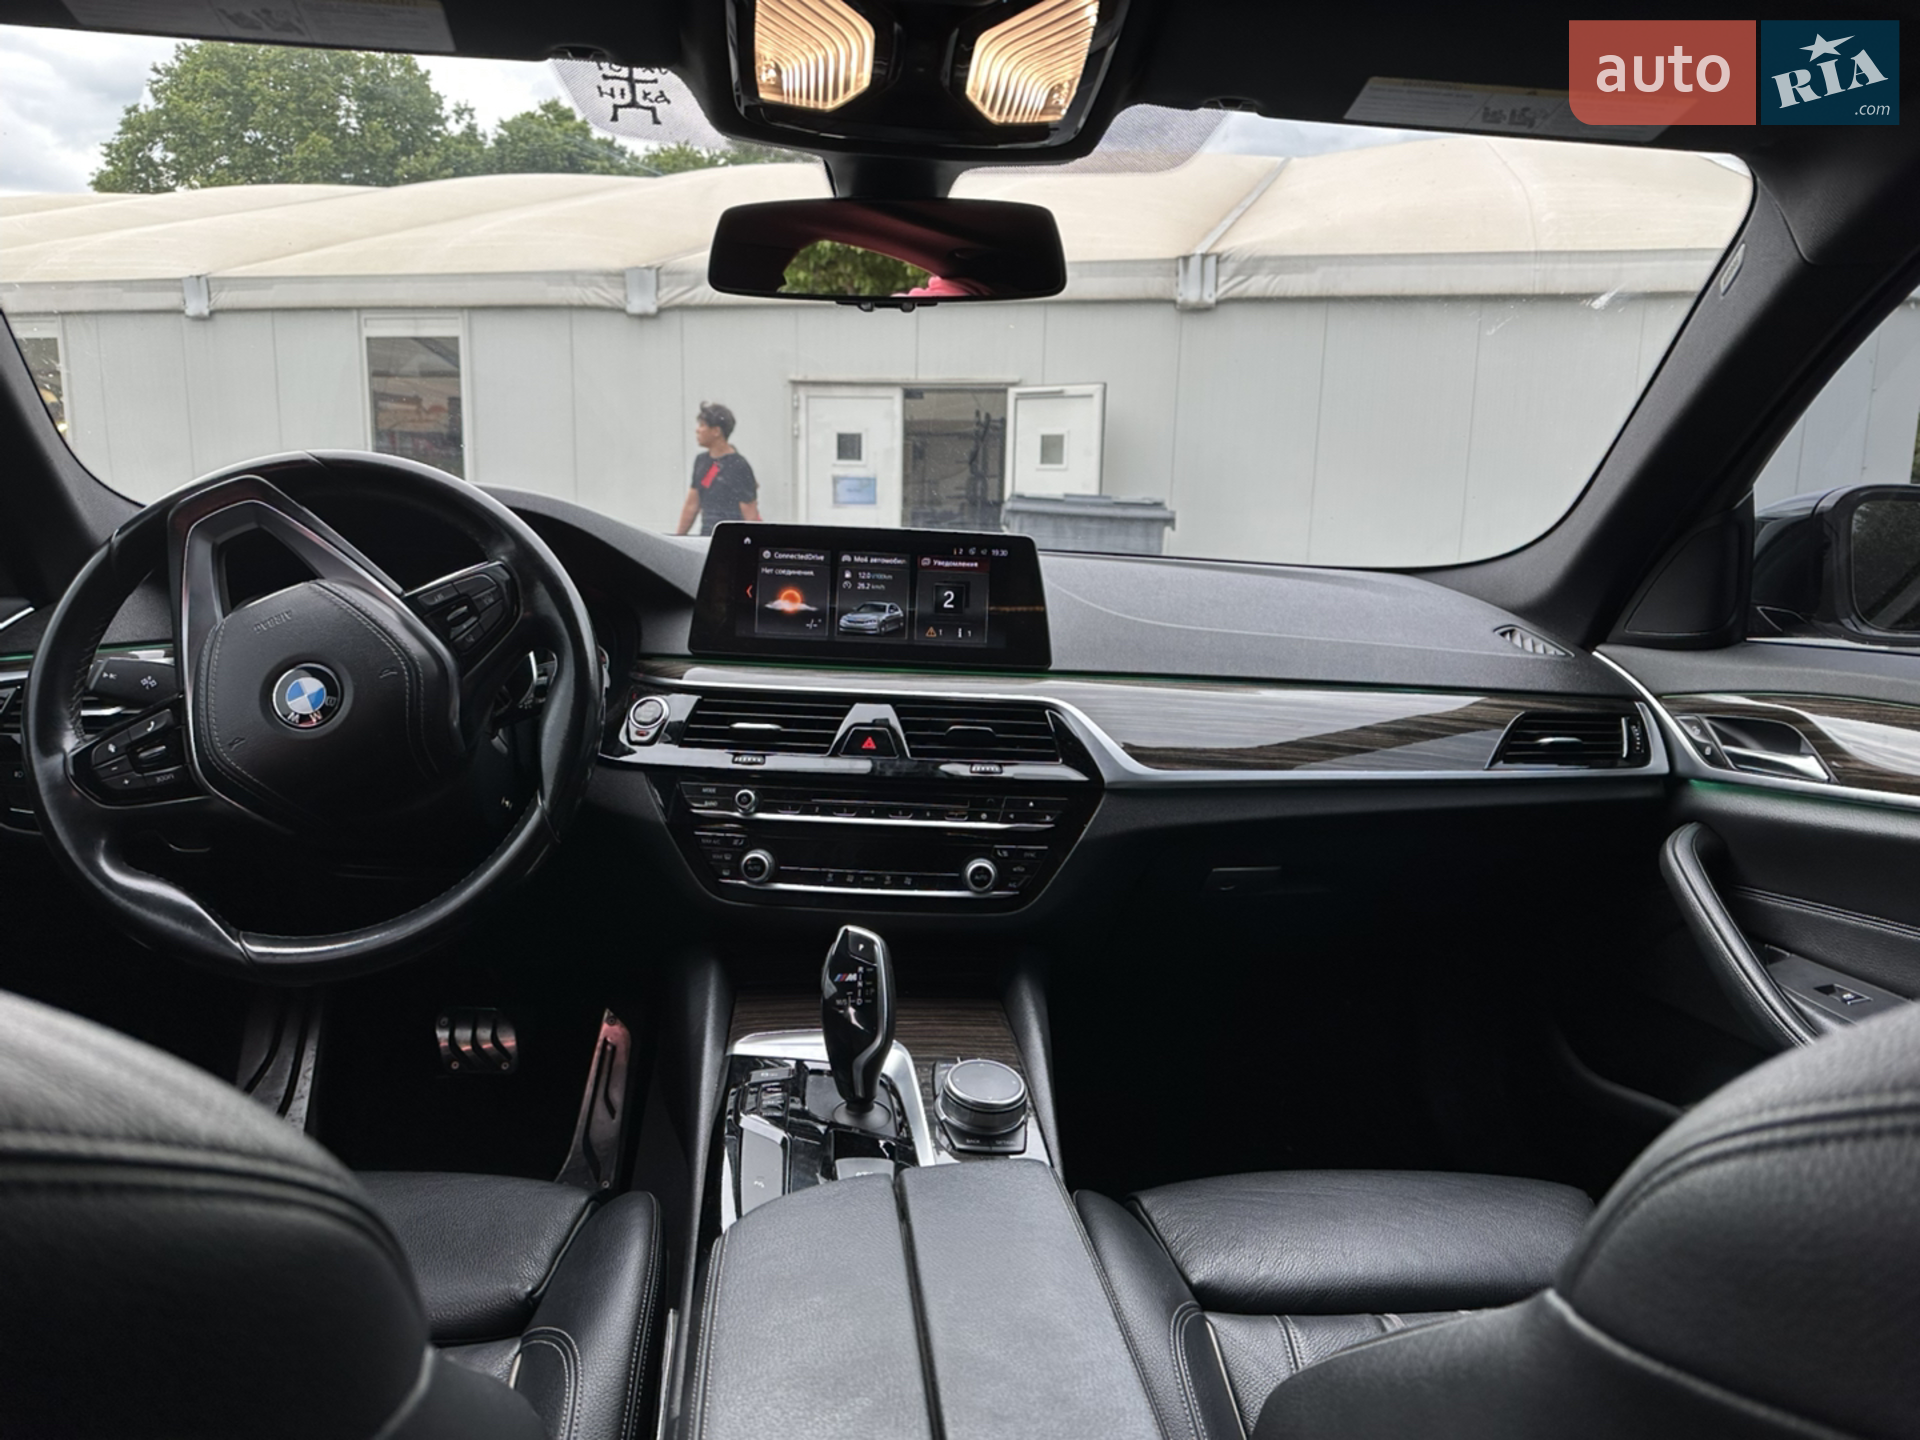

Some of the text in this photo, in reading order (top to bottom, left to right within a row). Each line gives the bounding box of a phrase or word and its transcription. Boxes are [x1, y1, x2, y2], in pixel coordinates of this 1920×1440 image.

[773, 551, 825, 561] ConnectedDrive
[853, 555, 868, 564] Мой
[933, 559, 979, 568] Уведомления
[761, 567, 773, 575] Нет
[943, 590, 955, 609] 2
[287, 695, 338, 724] BMW
[858, 943, 865, 952] P
